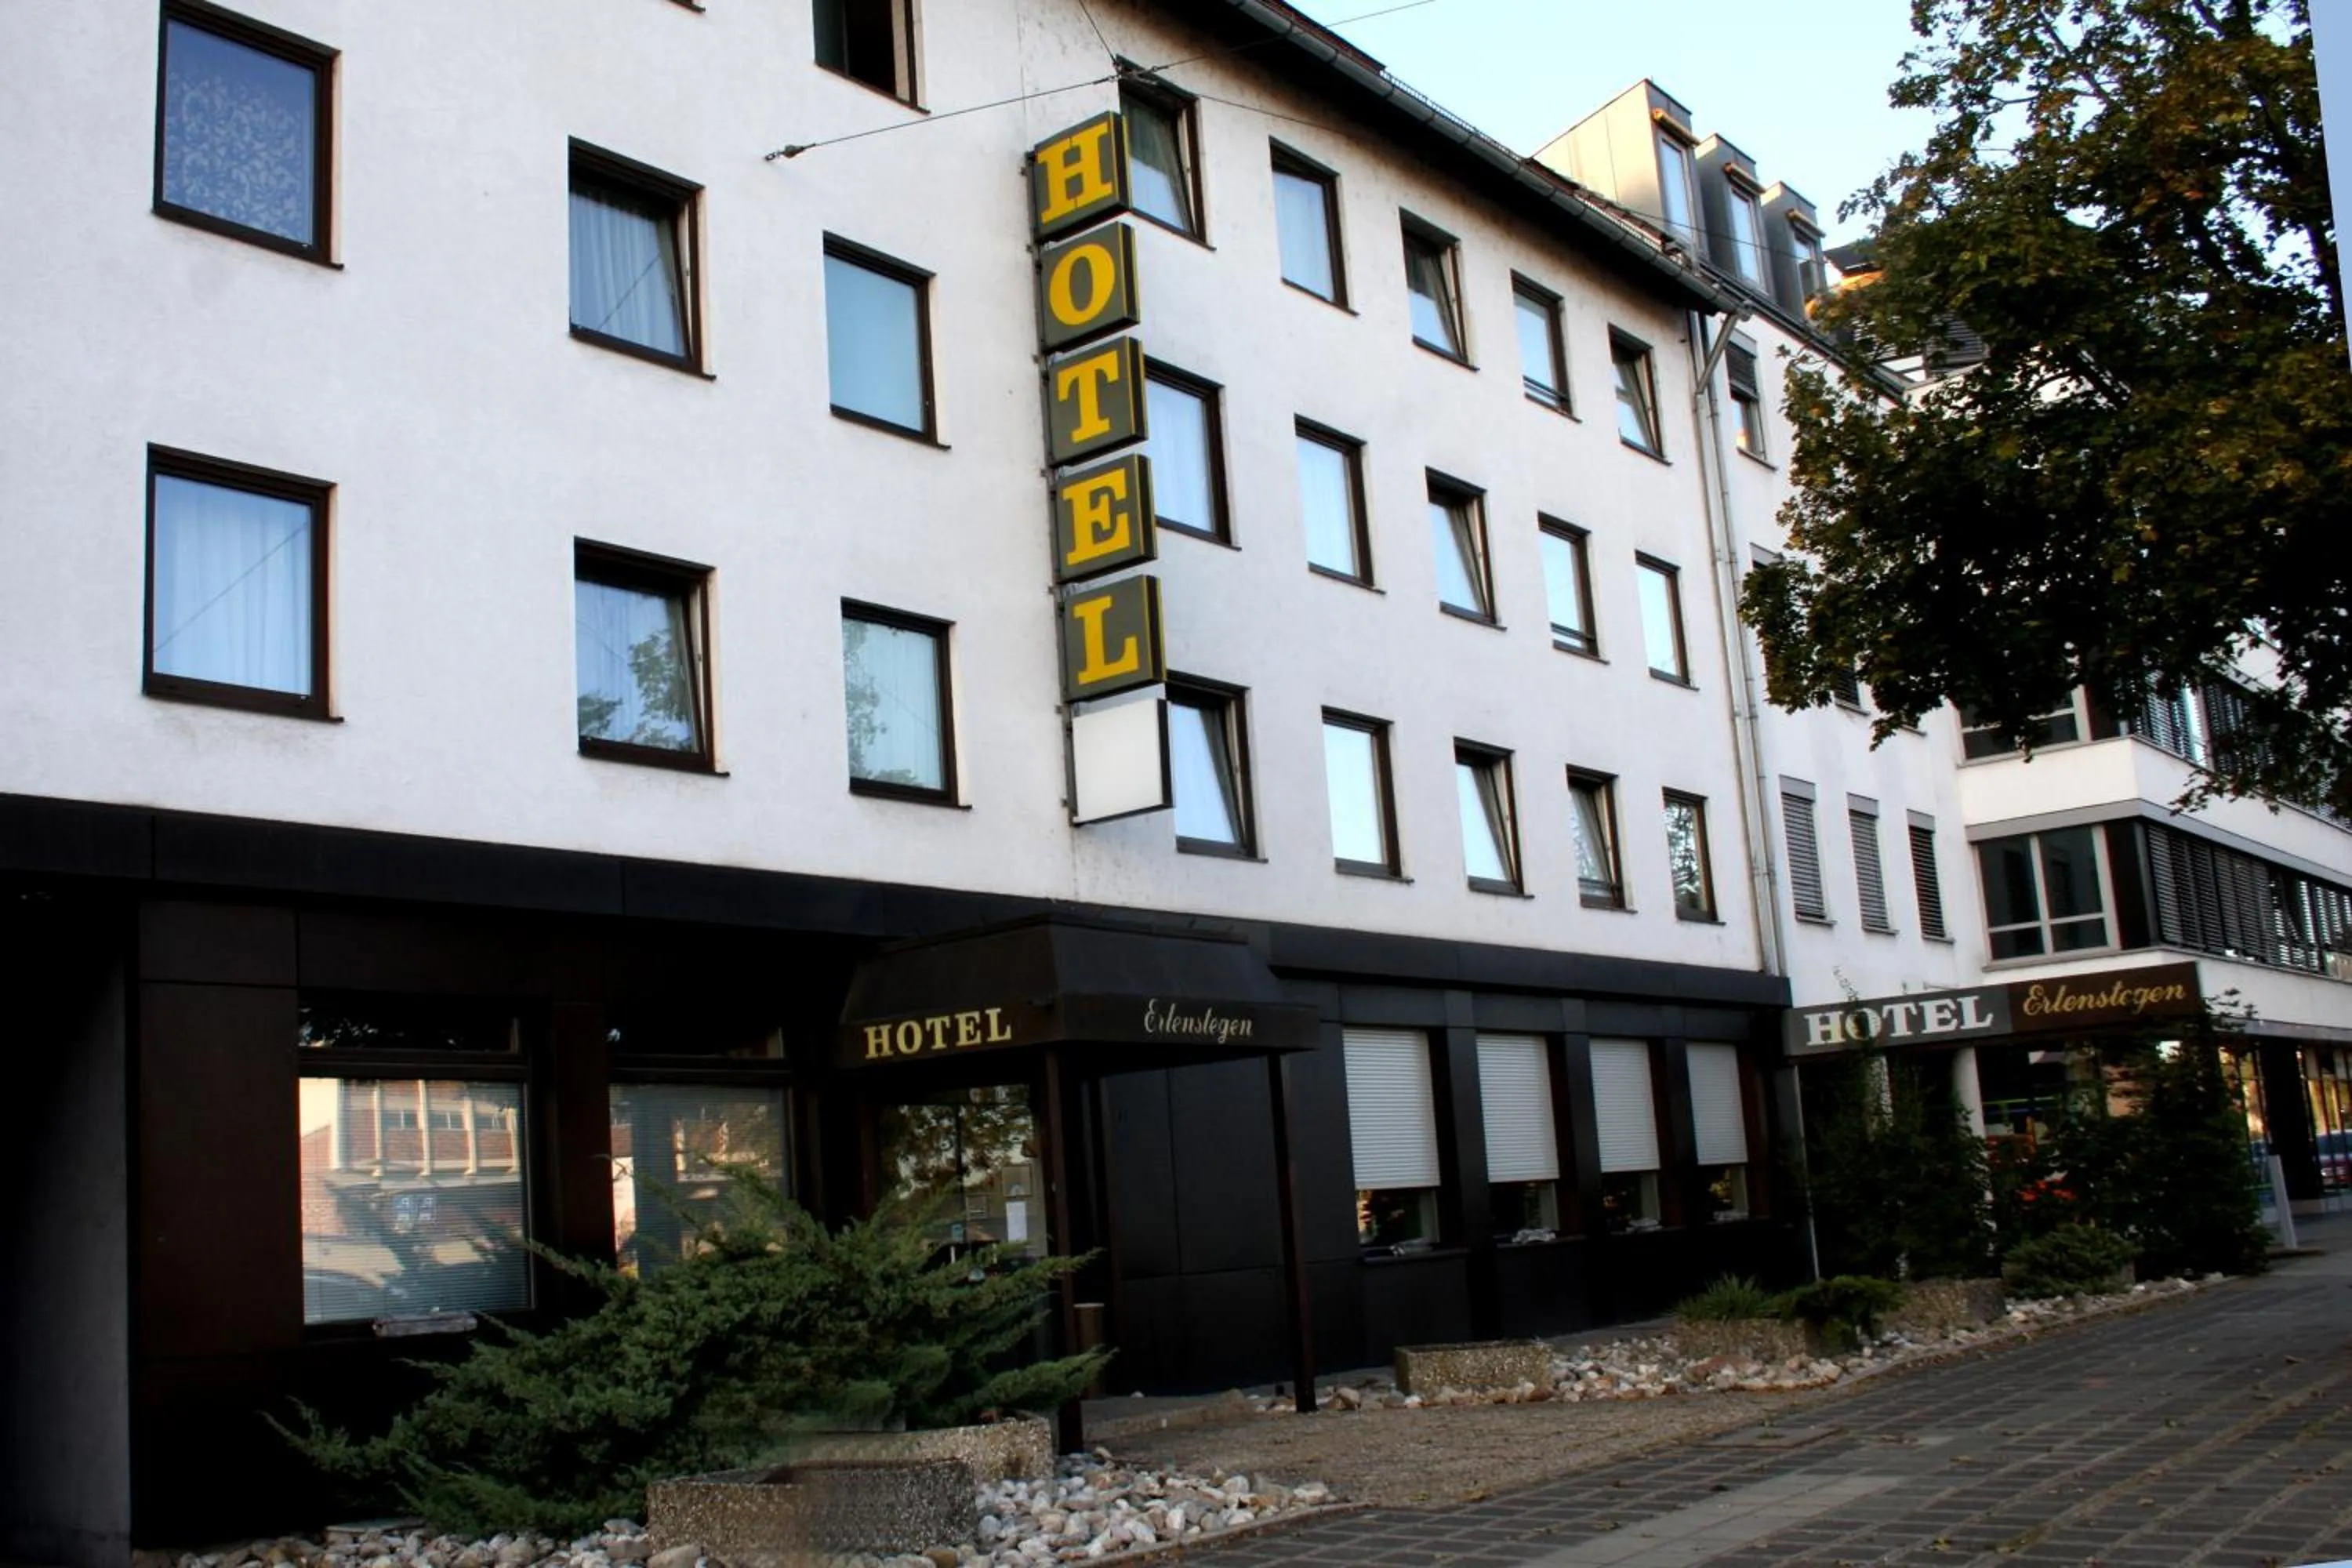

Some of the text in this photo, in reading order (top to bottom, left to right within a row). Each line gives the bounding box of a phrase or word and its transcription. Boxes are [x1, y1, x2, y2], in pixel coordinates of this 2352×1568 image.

[1037, 121, 1141, 684] HOTEL
[1803, 995, 1994, 1047] HOTEL
[2023, 980, 2186, 1017] Erlenstegen
[864, 1007, 1012, 1059] HOTEL
